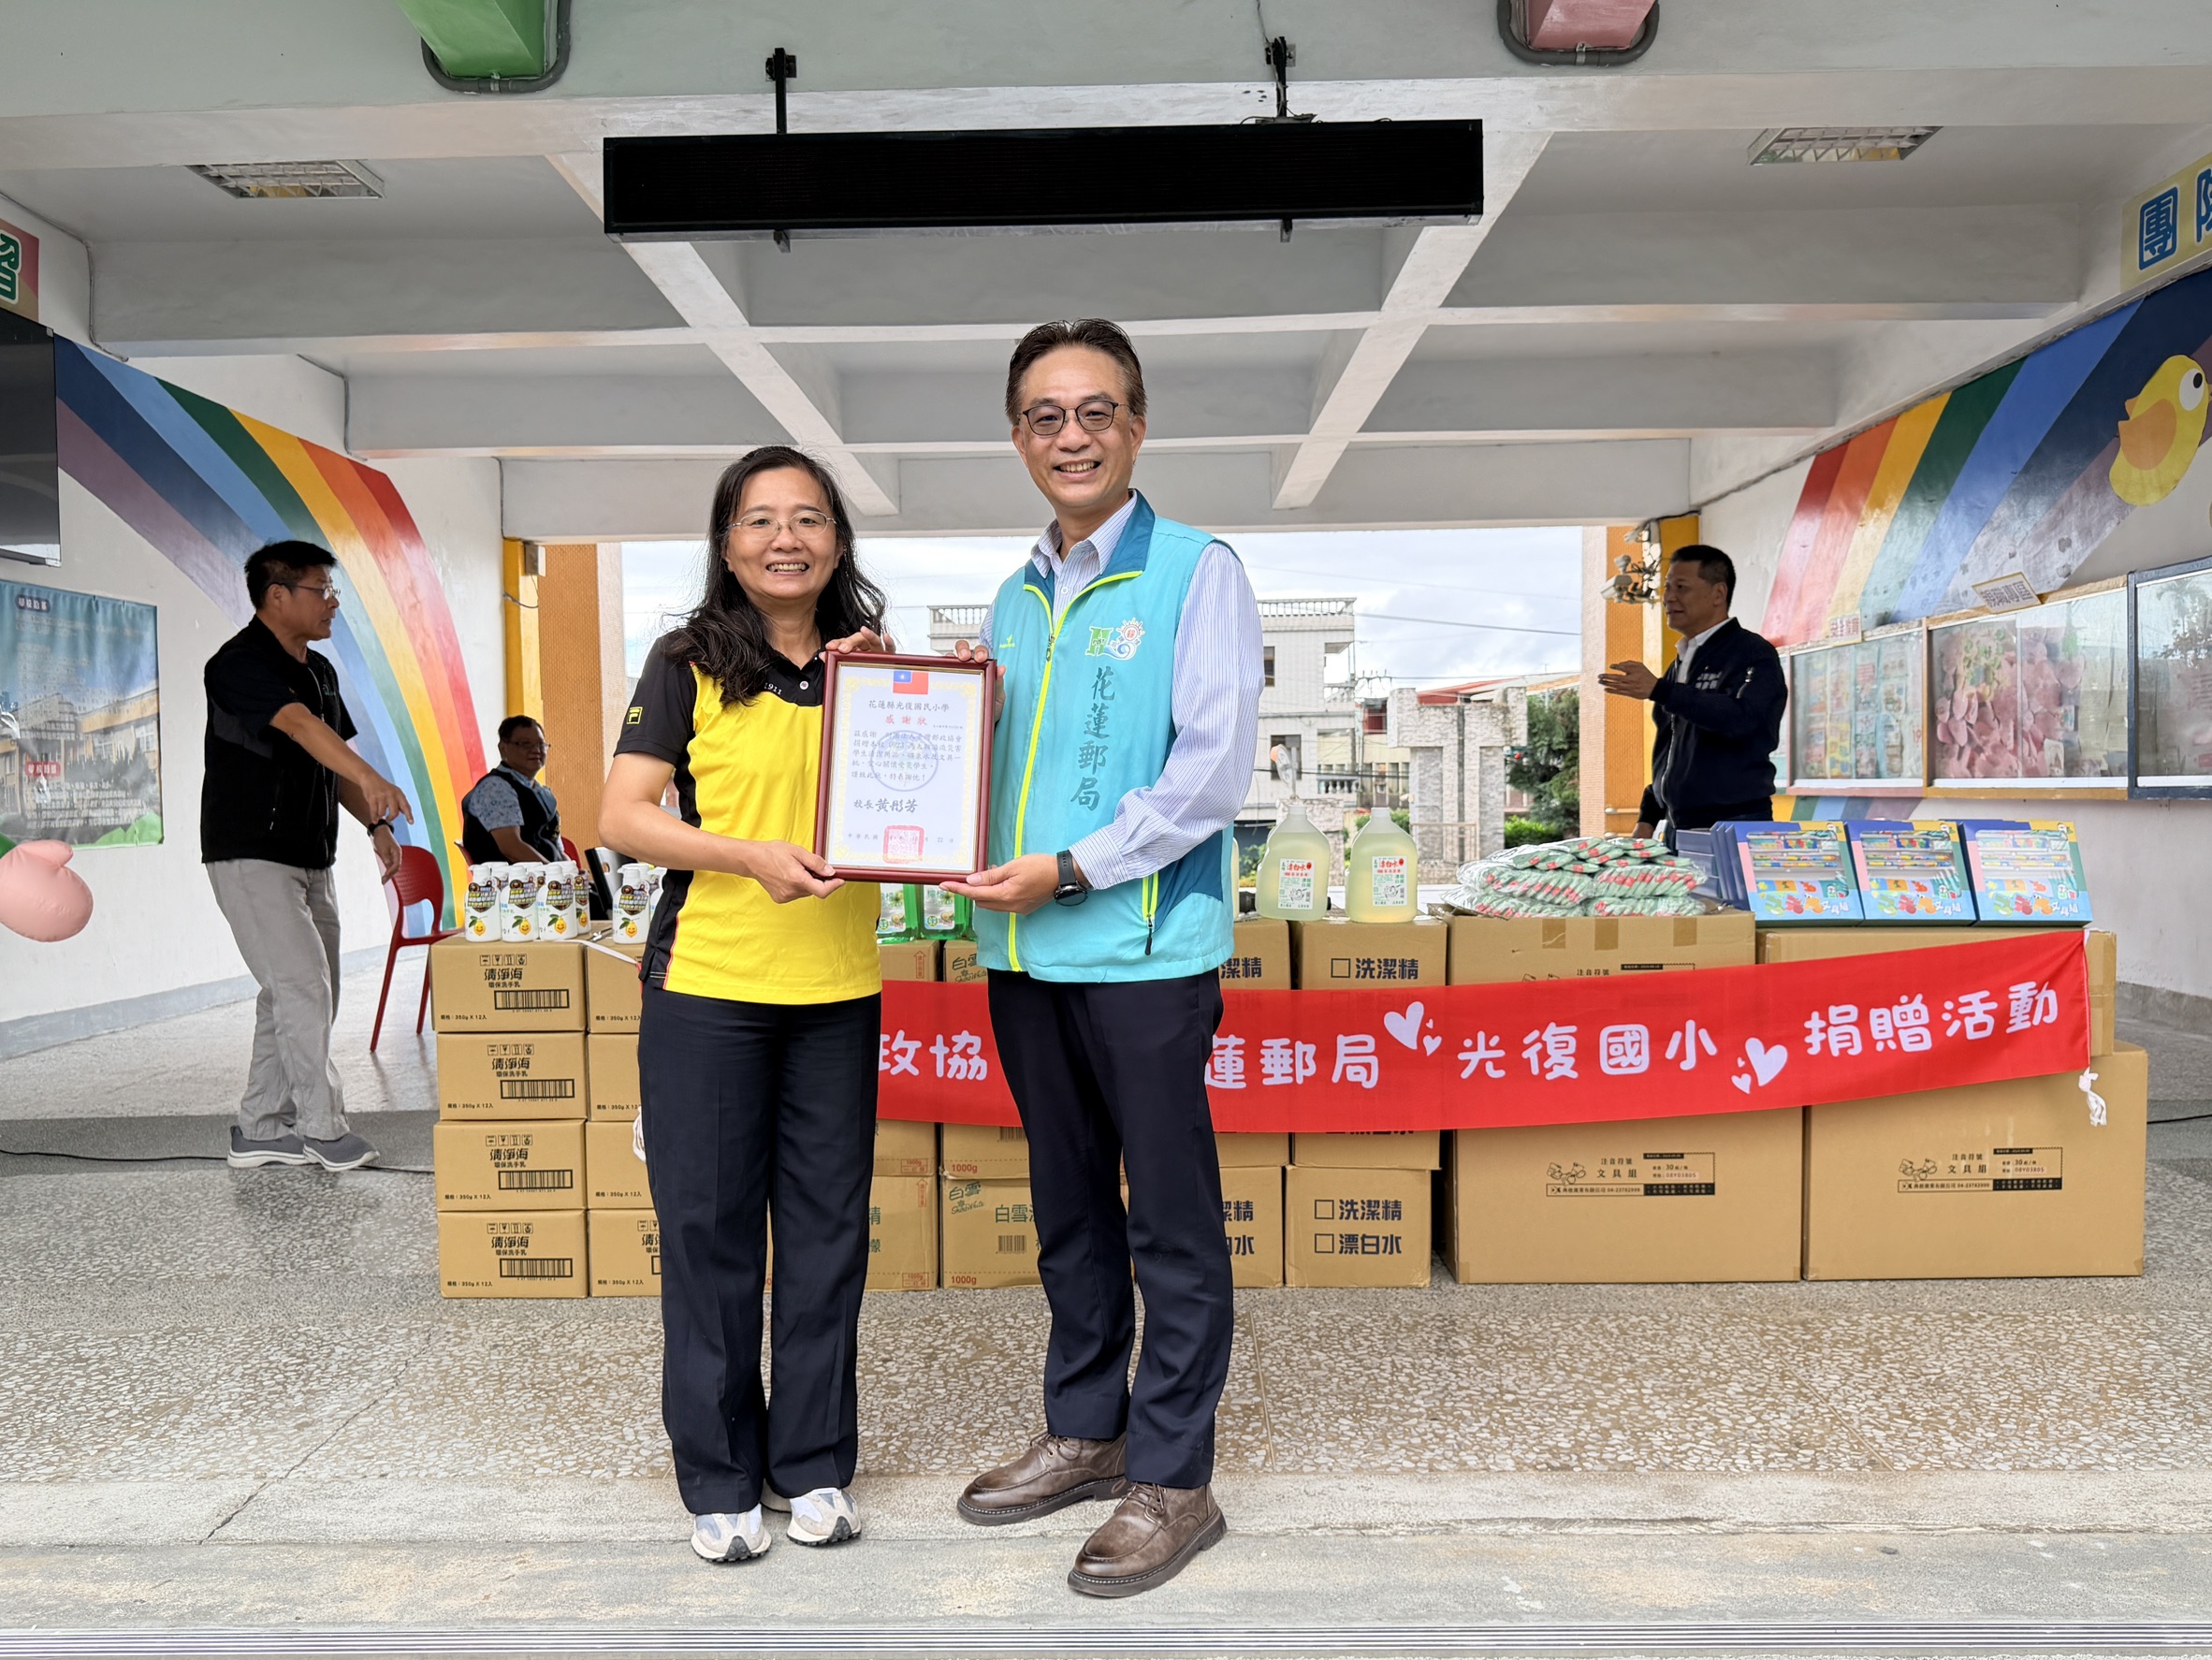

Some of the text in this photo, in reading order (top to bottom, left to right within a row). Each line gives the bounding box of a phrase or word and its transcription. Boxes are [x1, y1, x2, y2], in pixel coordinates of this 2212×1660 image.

[868, 700, 950, 713] 花蓮縣光復國民小學
[885, 715, 927, 726] 感謝狀
[1070, 666, 1116, 811] 花蓮郵局
[853, 798, 918, 813] 校長黃彤芳
[485, 968, 523, 982] 清淨海
[1356, 958, 1419, 980] 洗潔精
[1204, 1034, 1378, 1088] 蓮郵局
[1457, 1019, 1717, 1081] 光復國小
[1803, 980, 2058, 1057] 捐贈活動
[491, 1057, 531, 1070] 清淨海
[489, 1147, 529, 1160] 清淨海
[952, 1164, 978, 1173] 1000g
[1596, 1169, 1637, 1178] 文具組
[1947, 1164, 1986, 1174] 文具組
[949, 1182, 982, 1201] 白雪
[1338, 1199, 1402, 1220] 洗潔精
[491, 1236, 530, 1248] 清淨海
[1338, 1233, 1402, 1255] 漂白水
[951, 1275, 977, 1286] 1000g
